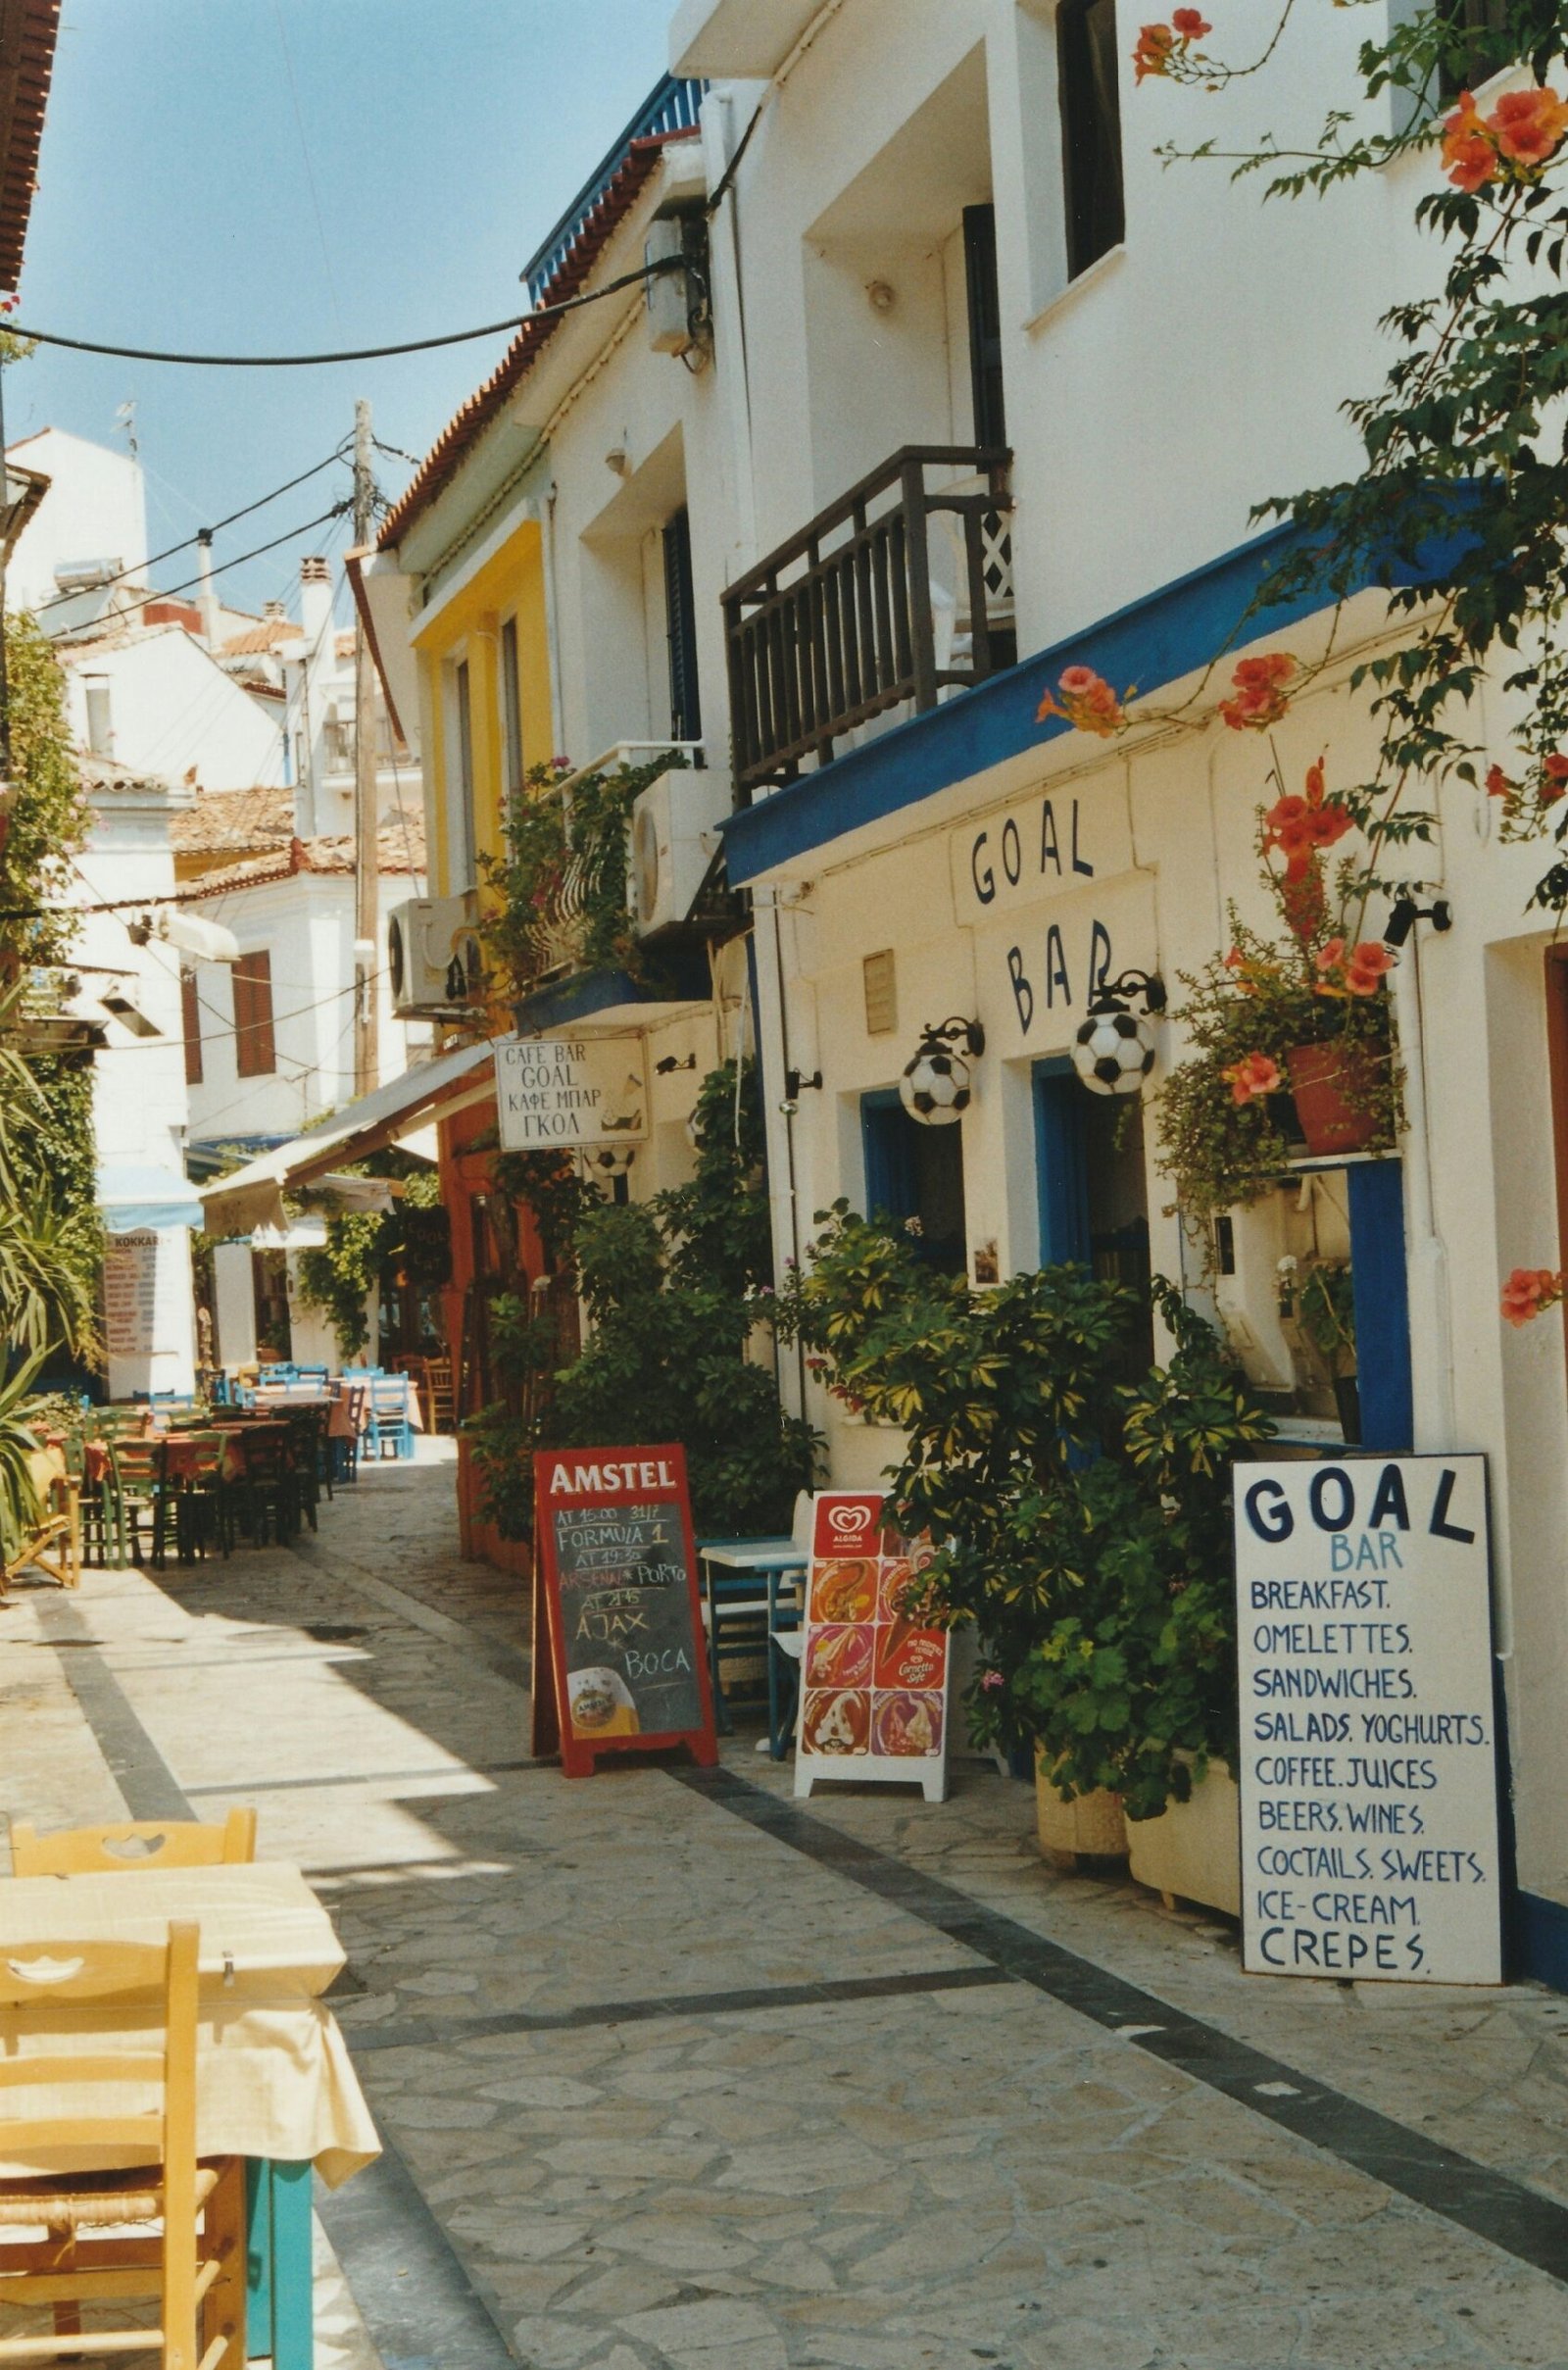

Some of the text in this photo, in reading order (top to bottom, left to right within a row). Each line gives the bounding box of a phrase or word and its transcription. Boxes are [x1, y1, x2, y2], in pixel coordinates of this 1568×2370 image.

[972, 799, 1094, 905] GOAL
[1007, 918, 1111, 1036] BAR
[506, 1044, 586, 1065] CAFE BAR
[521, 1064, 578, 1089] GOAL
[509, 1089, 602, 1111] ΚΑΦΕ ΜΠΑΡ
[524, 1112, 580, 1137] ΓΚΟΛ
[550, 1460, 676, 1495] AMSTEL
[558, 1509, 574, 1527] AT
[1245, 1463, 1476, 1545] GOAL
[558, 1523, 669, 1553] FORMULA 1
[833, 1534, 862, 1543] ALGIDA
[1330, 1531, 1403, 1573] BAR
[575, 1553, 597, 1567] AT
[580, 1594, 601, 1609] AT
[1250, 1579, 1391, 1609] BREAKFAST.
[575, 1612, 649, 1641] AJAX
[1253, 1624, 1413, 1654] OMELETTES.
[624, 1648, 690, 1680] BOCA
[1252, 1668, 1417, 1700] SANDWICHES.
[1254, 1711, 1491, 1746] SALADS. YOGHURTS.
[1257, 1846, 1487, 1883] COCTAILS. SWEETS.
[1257, 1890, 1421, 1926] ICE-CREAM.
[1260, 1927, 1432, 1975] CREPES.
